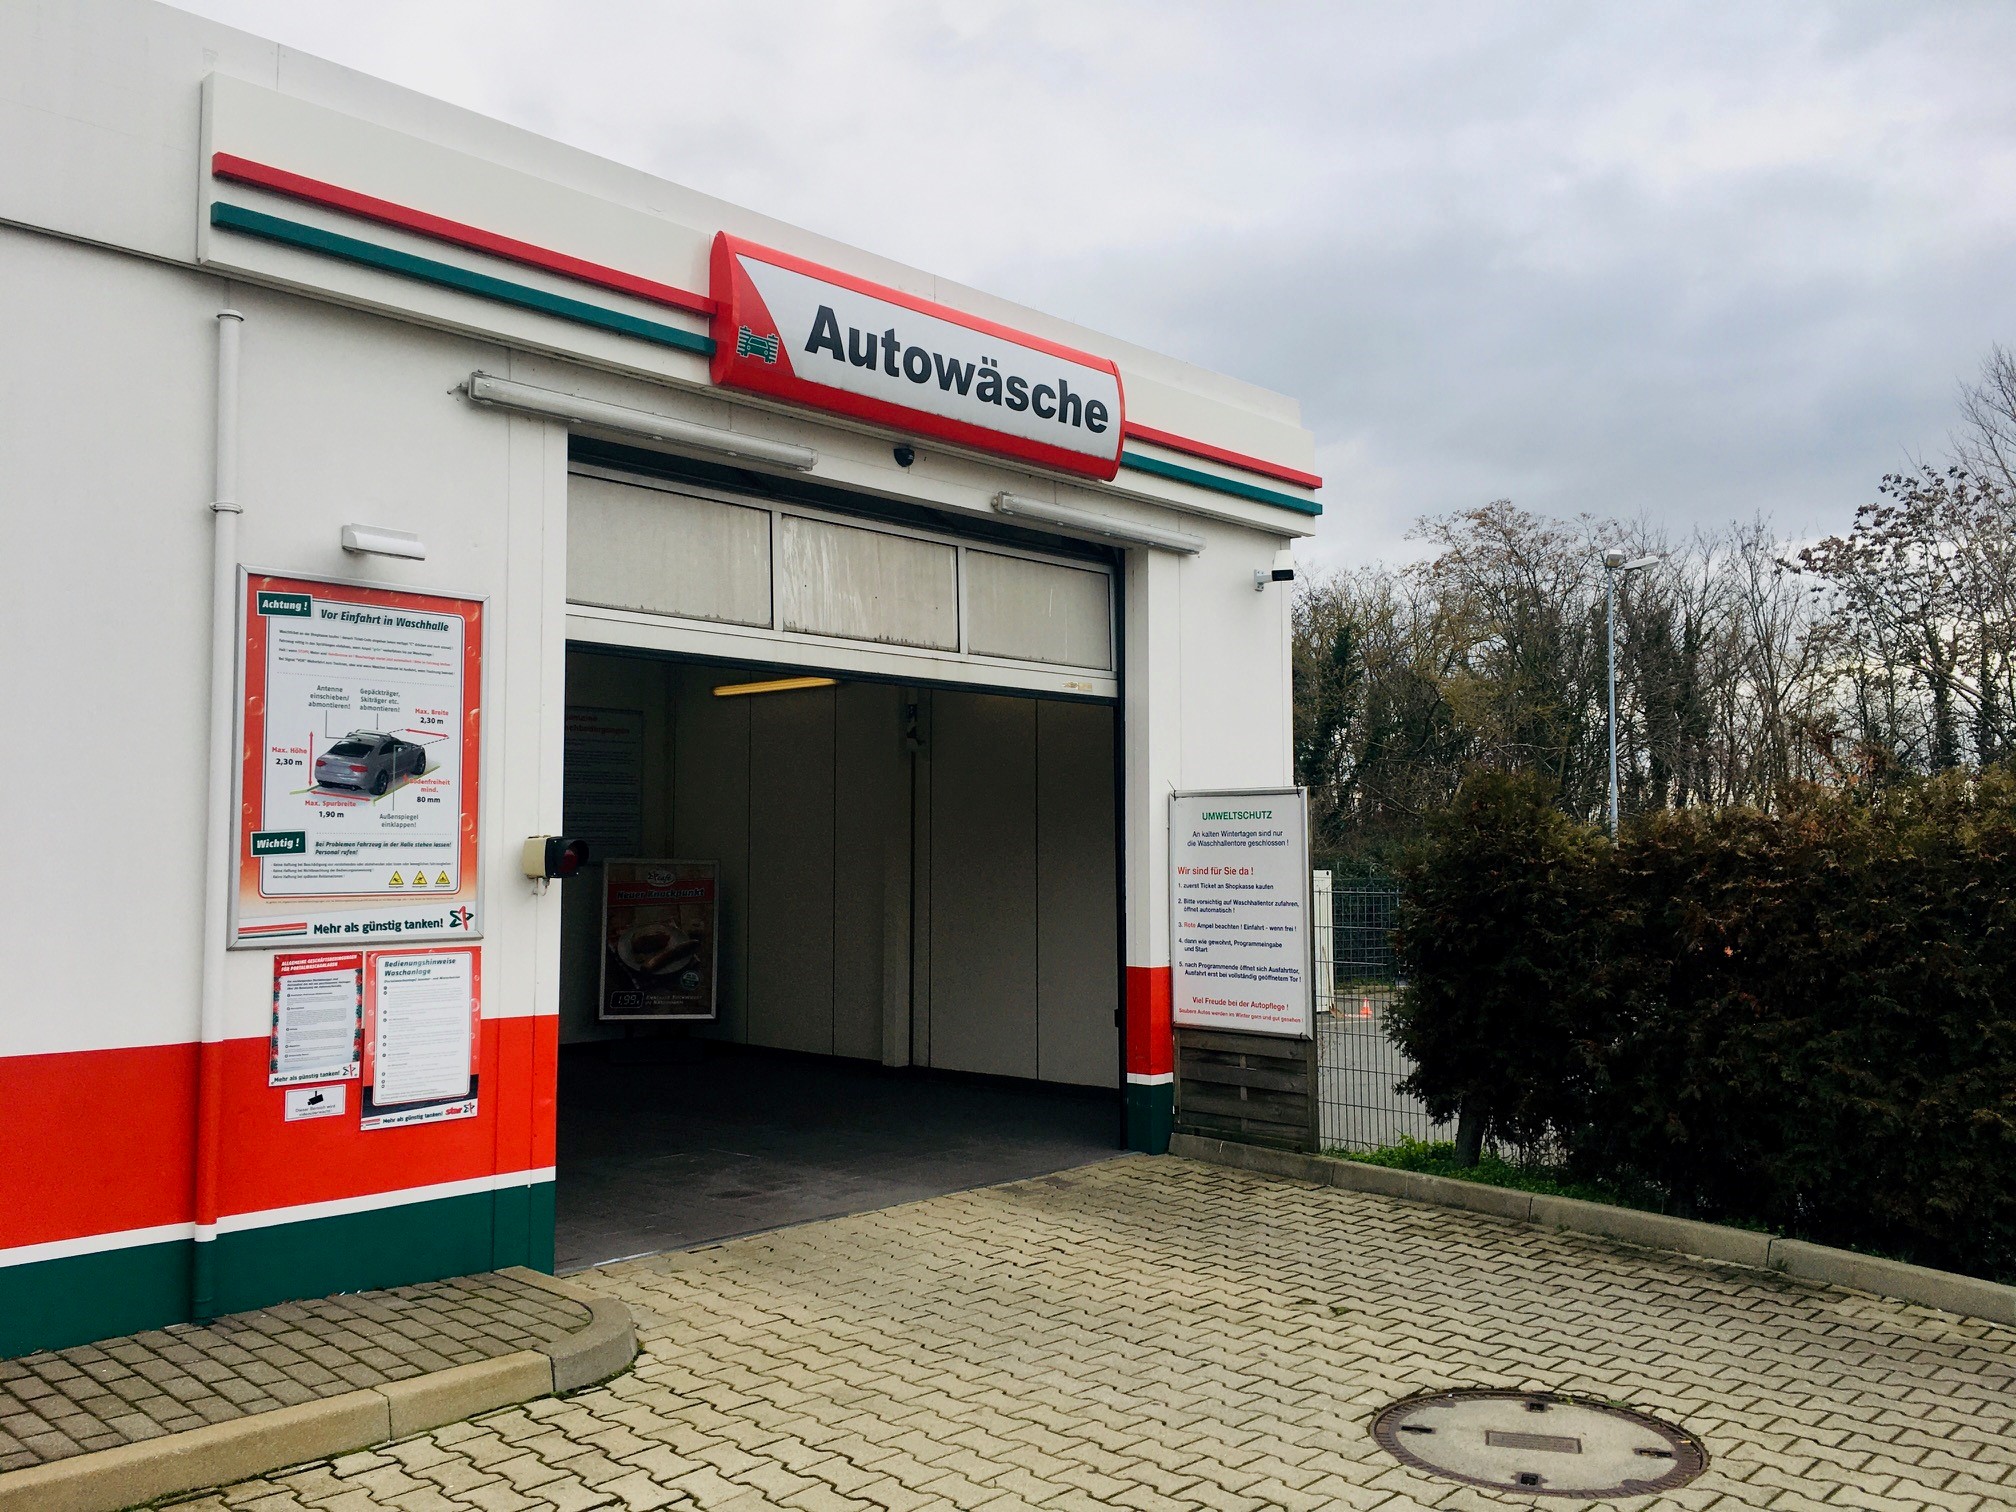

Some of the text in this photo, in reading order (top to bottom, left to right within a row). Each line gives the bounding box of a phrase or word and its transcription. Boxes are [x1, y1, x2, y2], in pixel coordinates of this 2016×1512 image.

[805, 305, 1108, 434] Autowäsche
[263, 599, 308, 611] Achtung !
[321, 609, 449, 632] Vor Einfahrt in Waschhalle
[431, 708, 449, 716] Breite
[276, 758, 294, 766] 2,30
[1202, 811, 1272, 821] UMWELTSCHUTZ
[1221, 830, 1257, 838] Wintertagen
[257, 838, 300, 849] Wichtig !
[1248, 840, 1285, 848] geschlossen
[1178, 867, 1254, 876] Wir sind für Sie da !
[314, 918, 444, 934] Mehr als günstig tanken!
[1205, 998, 1226, 1006] Freude
[1228, 999, 1237, 1007] bei
[1251, 1001, 1285, 1011] Autopflege
